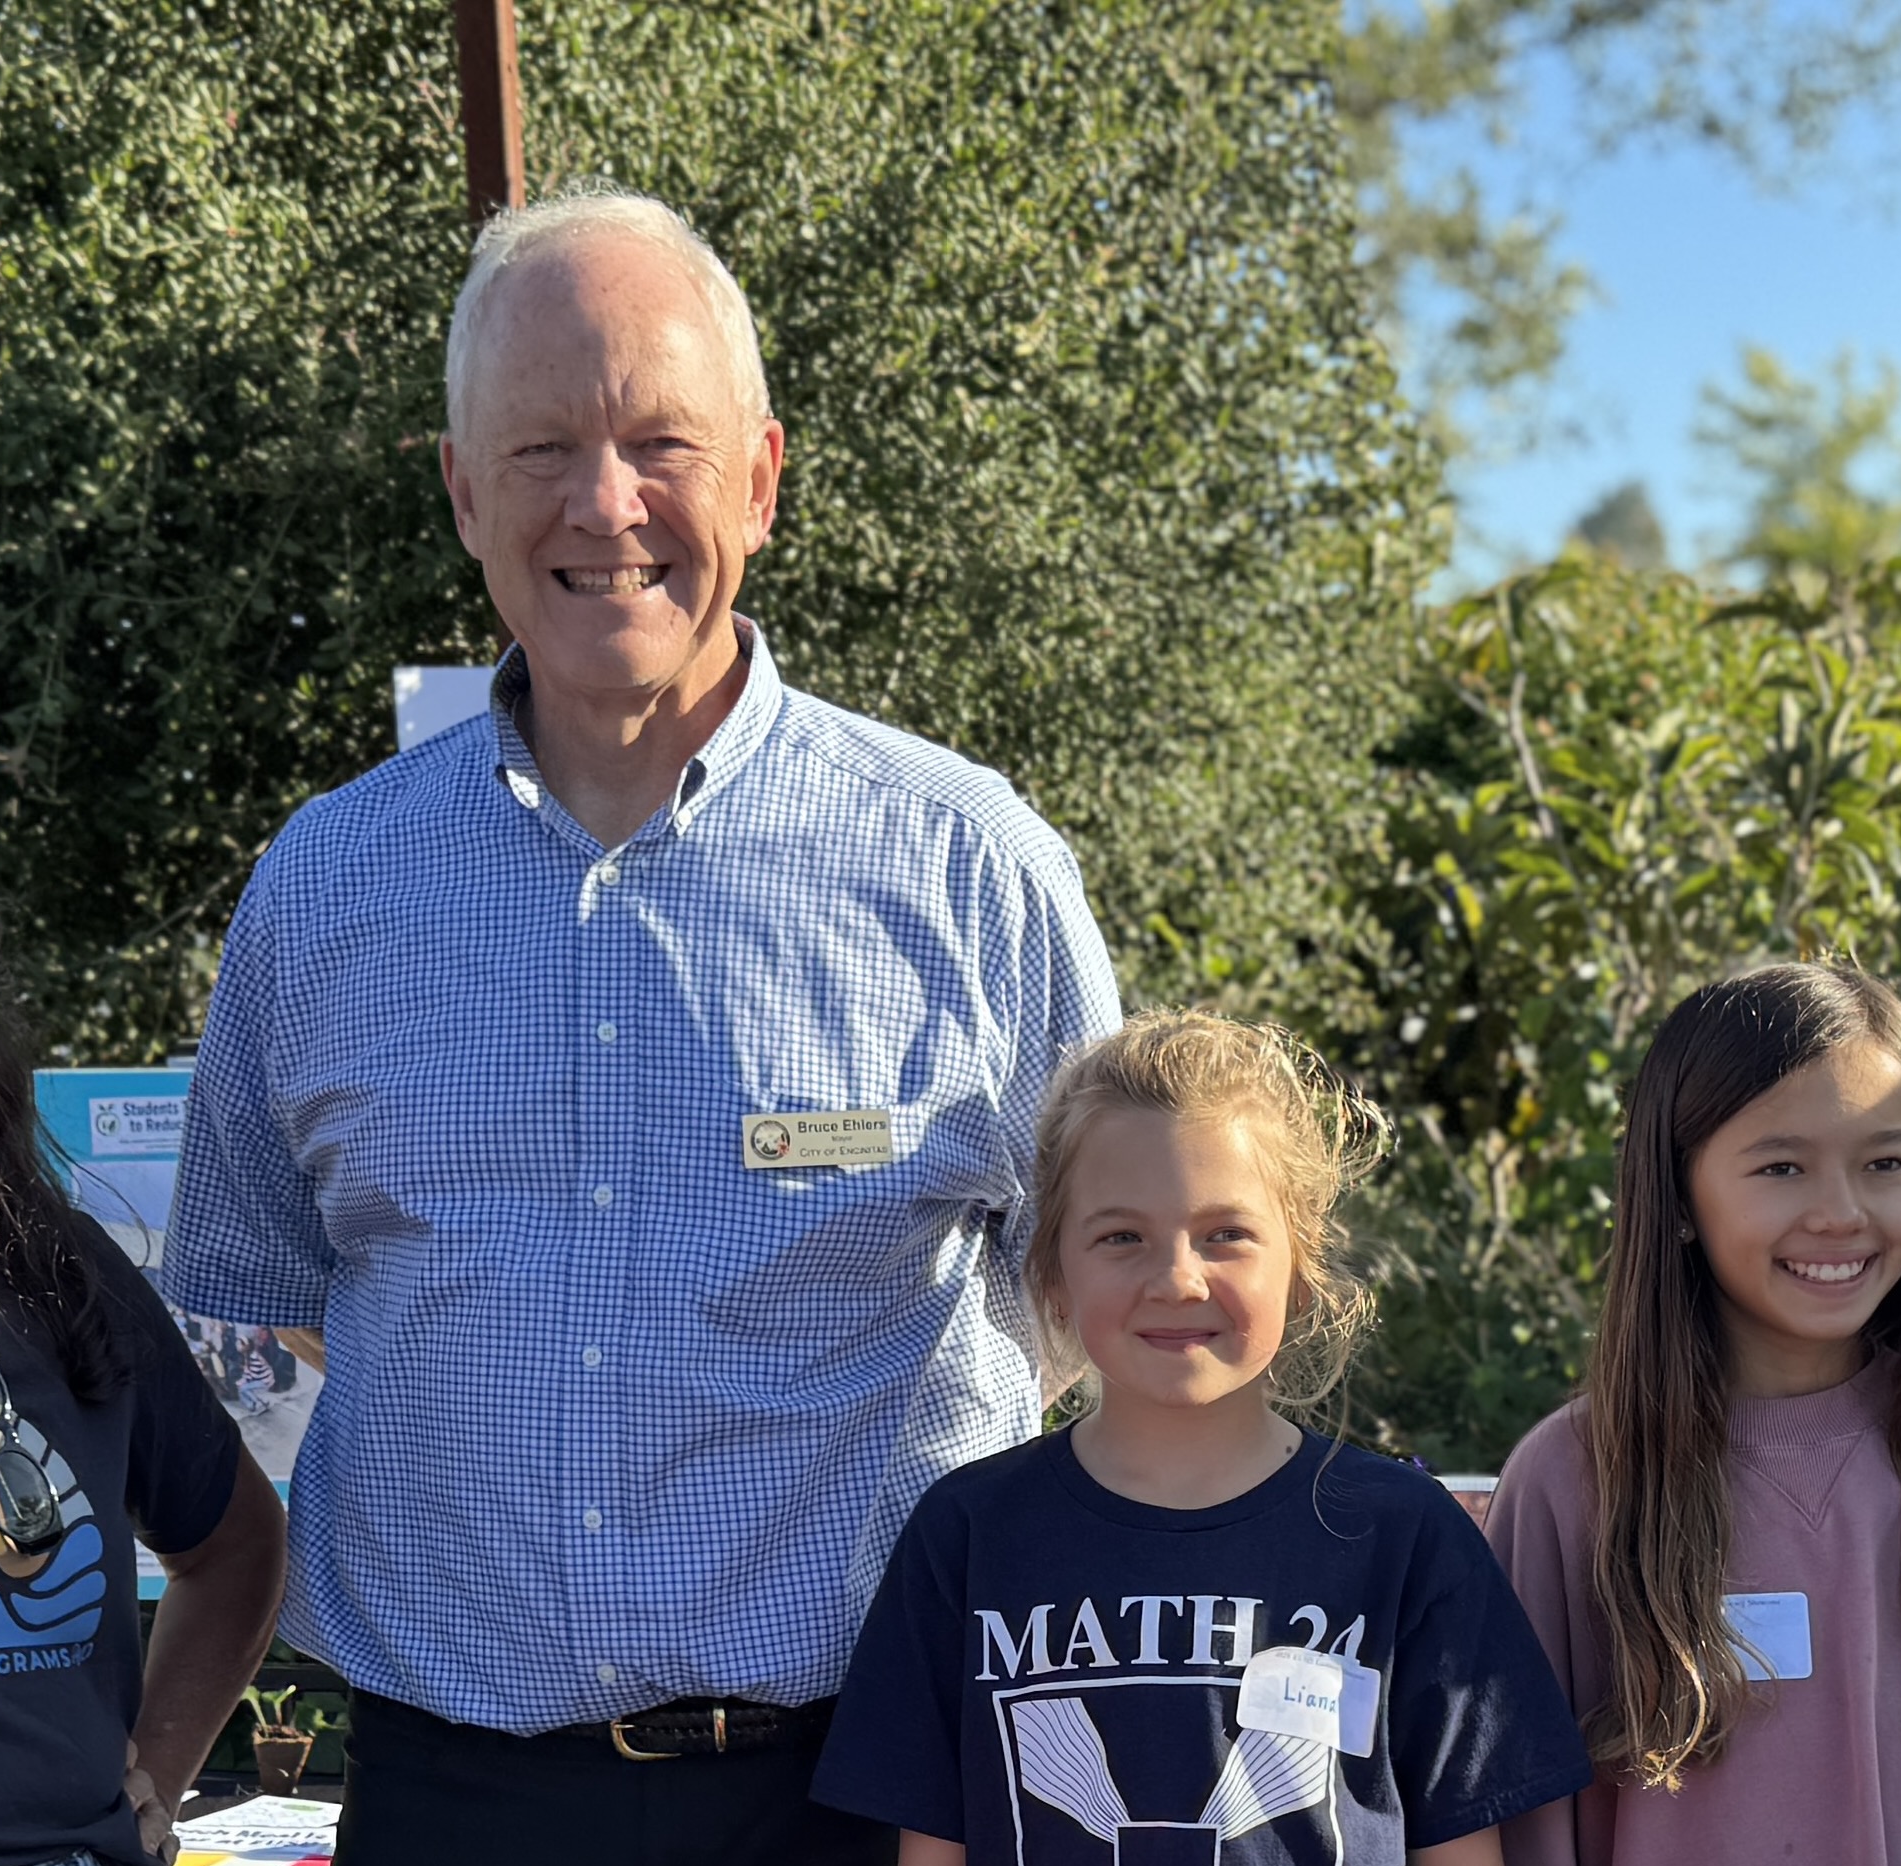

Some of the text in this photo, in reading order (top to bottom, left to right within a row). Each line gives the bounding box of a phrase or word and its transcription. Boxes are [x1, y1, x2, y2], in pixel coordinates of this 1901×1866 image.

[123, 1101, 179, 1116] Students
[130, 1120, 143, 1132] to
[798, 1118, 887, 1133] Bruce Ehlers
[973, 1595, 1263, 1681] MATH
[1284, 1676, 1337, 1713] Liana
